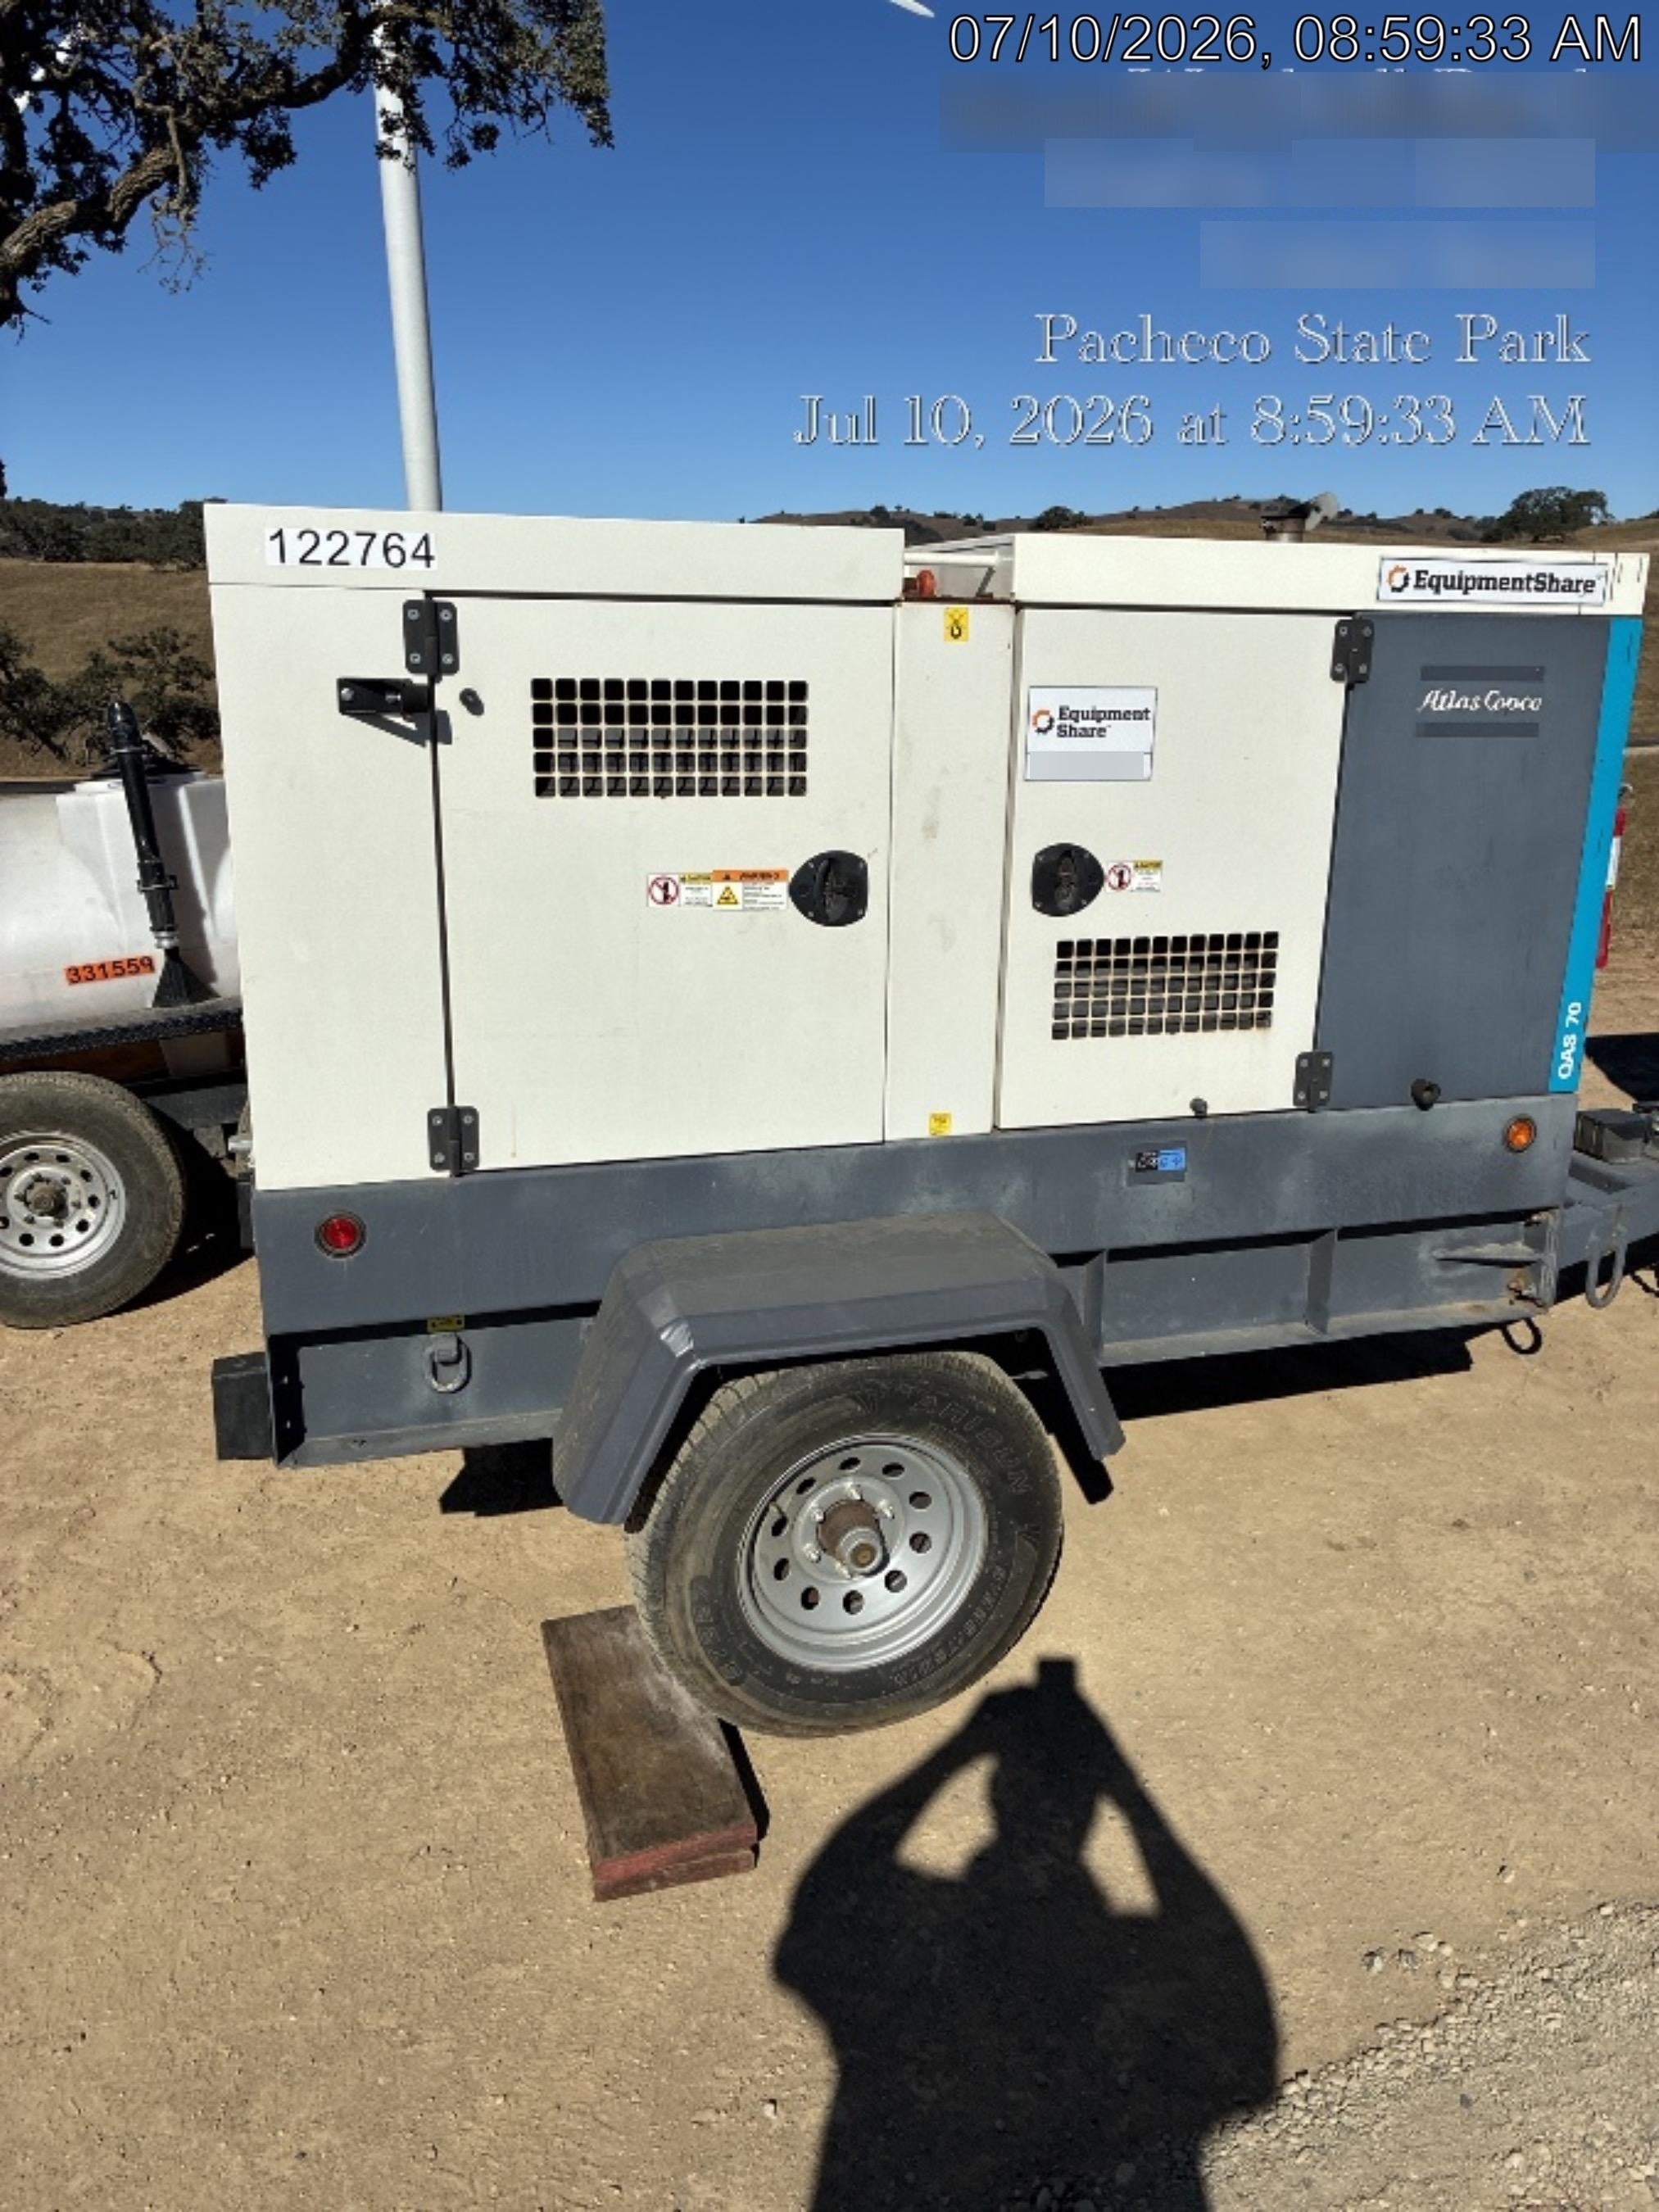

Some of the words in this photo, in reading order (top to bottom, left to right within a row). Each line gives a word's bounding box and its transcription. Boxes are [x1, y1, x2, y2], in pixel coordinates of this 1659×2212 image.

[270, 528, 435, 569] 122764
[1413, 569, 1596, 596] EquipmentShare
[1416, 688, 1481, 712] Atlas
[1058, 705, 1151, 723] Equipment
[1057, 724, 1108, 738] Share
[67, 955, 155, 984] 331559
[1565, 1001, 1582, 1028] 70
[1558, 1034, 1577, 1080] QAS
